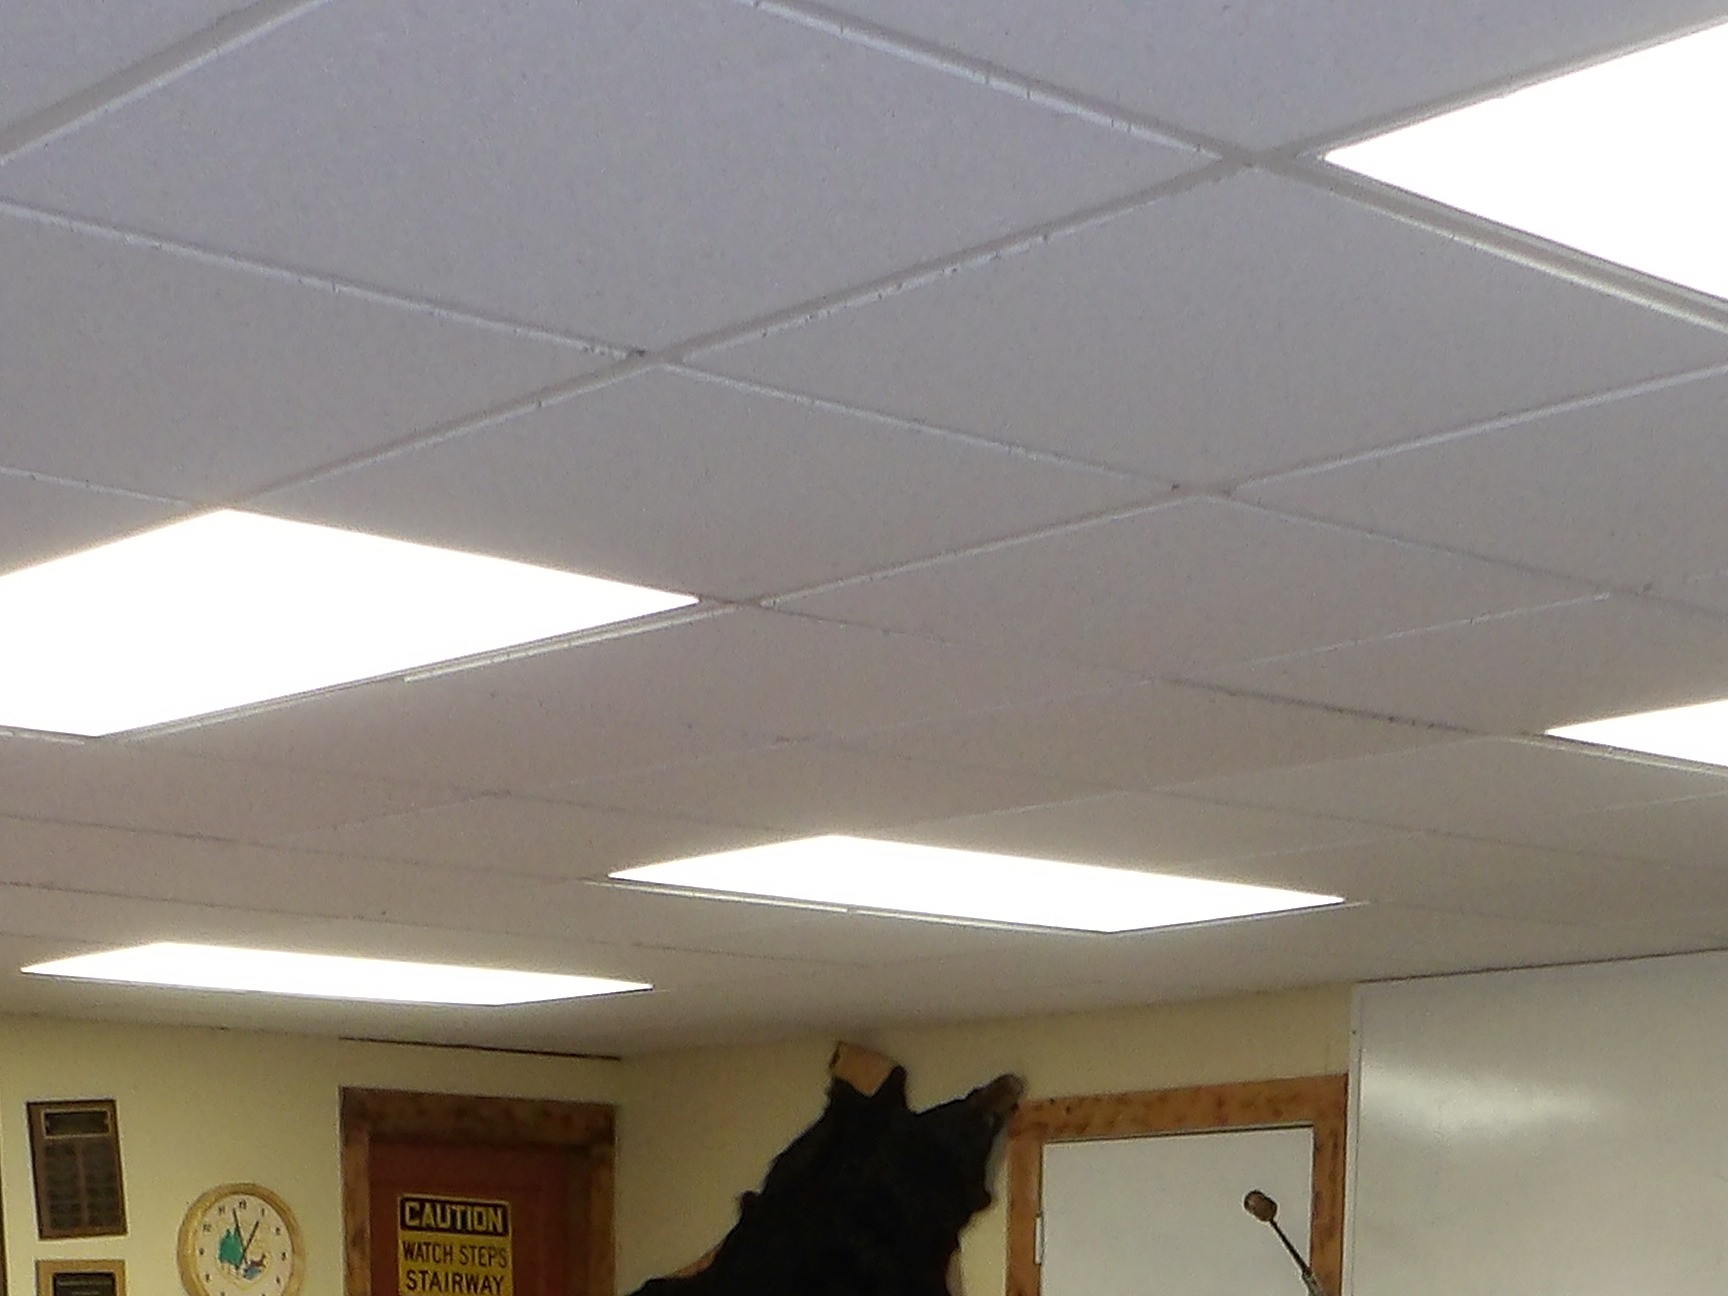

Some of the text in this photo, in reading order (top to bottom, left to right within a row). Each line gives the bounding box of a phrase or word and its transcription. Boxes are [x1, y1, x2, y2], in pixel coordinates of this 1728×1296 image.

[405, 1202, 503, 1233] CAUTION
[403, 1241, 507, 1268] WATCH STEPS
[406, 1269, 504, 1295] STAIRWAY
